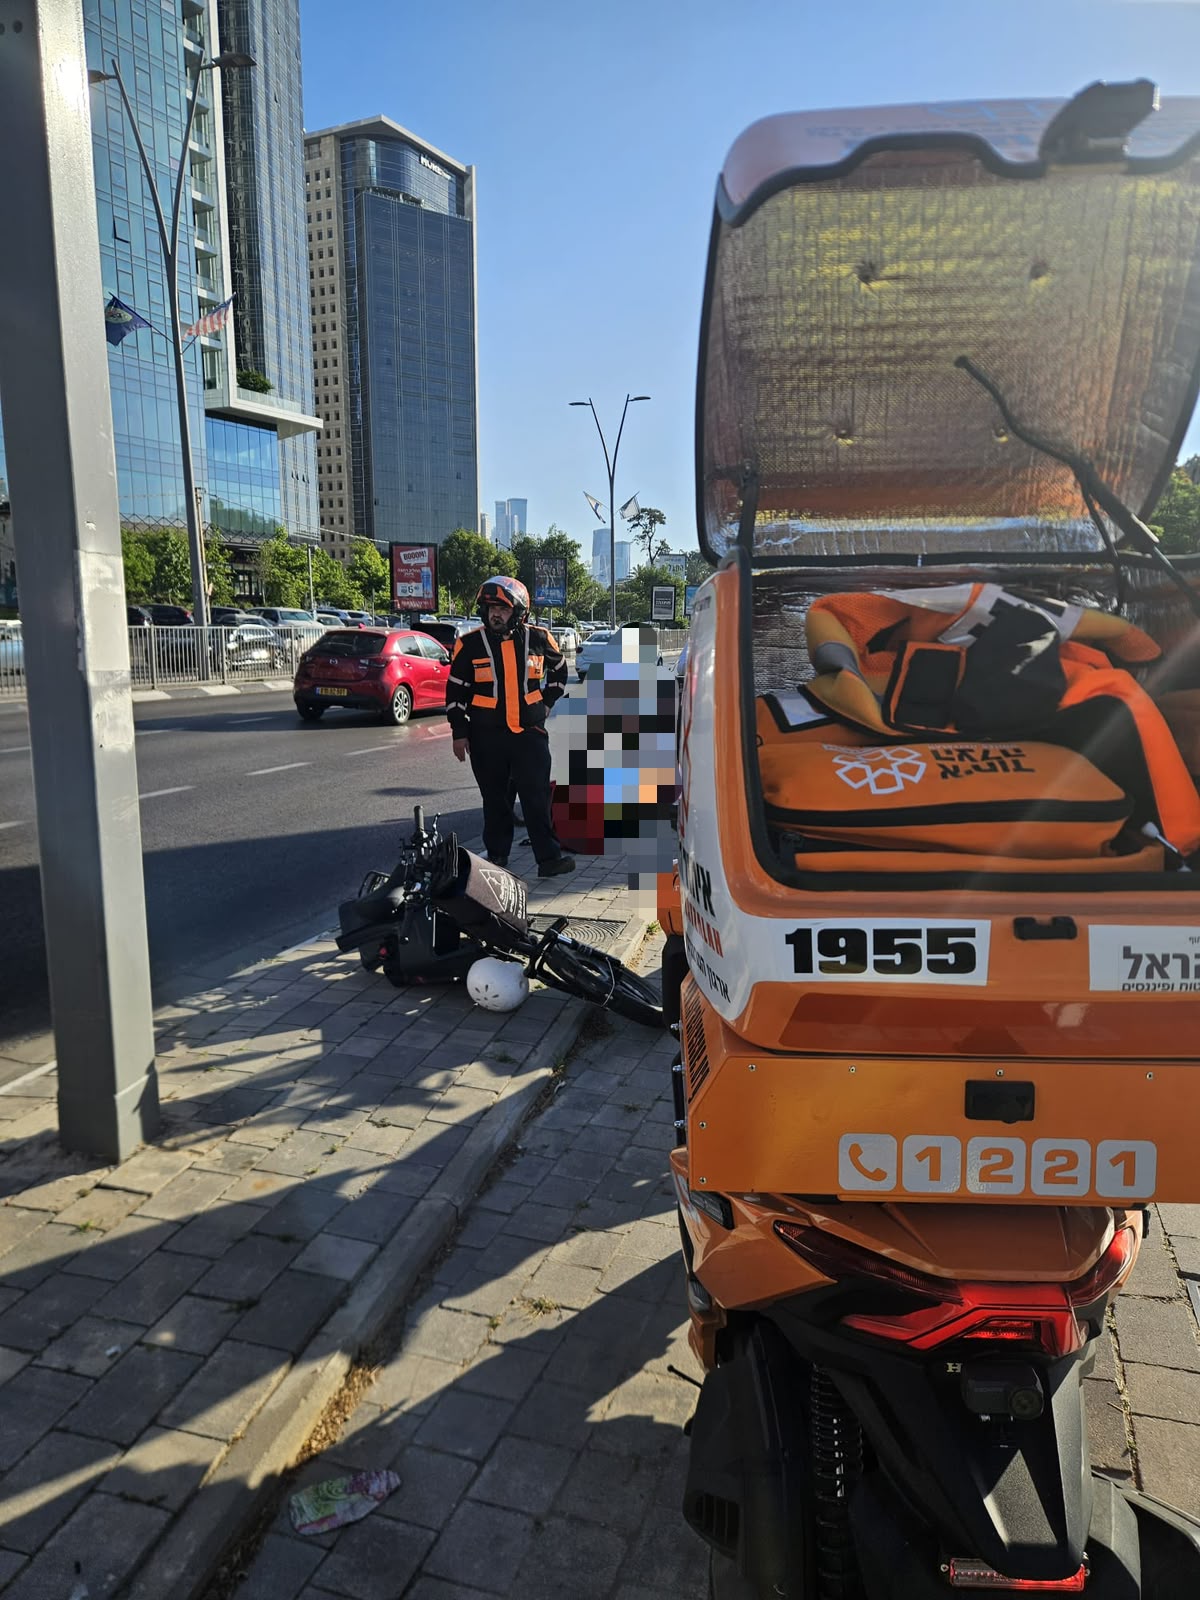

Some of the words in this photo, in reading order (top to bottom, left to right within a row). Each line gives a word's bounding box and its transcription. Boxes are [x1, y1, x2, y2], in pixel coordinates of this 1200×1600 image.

[930, 748, 1026, 762] הצלה
[937, 759, 1035, 779] איחוד
[785, 927, 977, 975] 1955
[1122, 945, 1200, 979] ראל
[914, 1145, 1136, 1187] 1221
